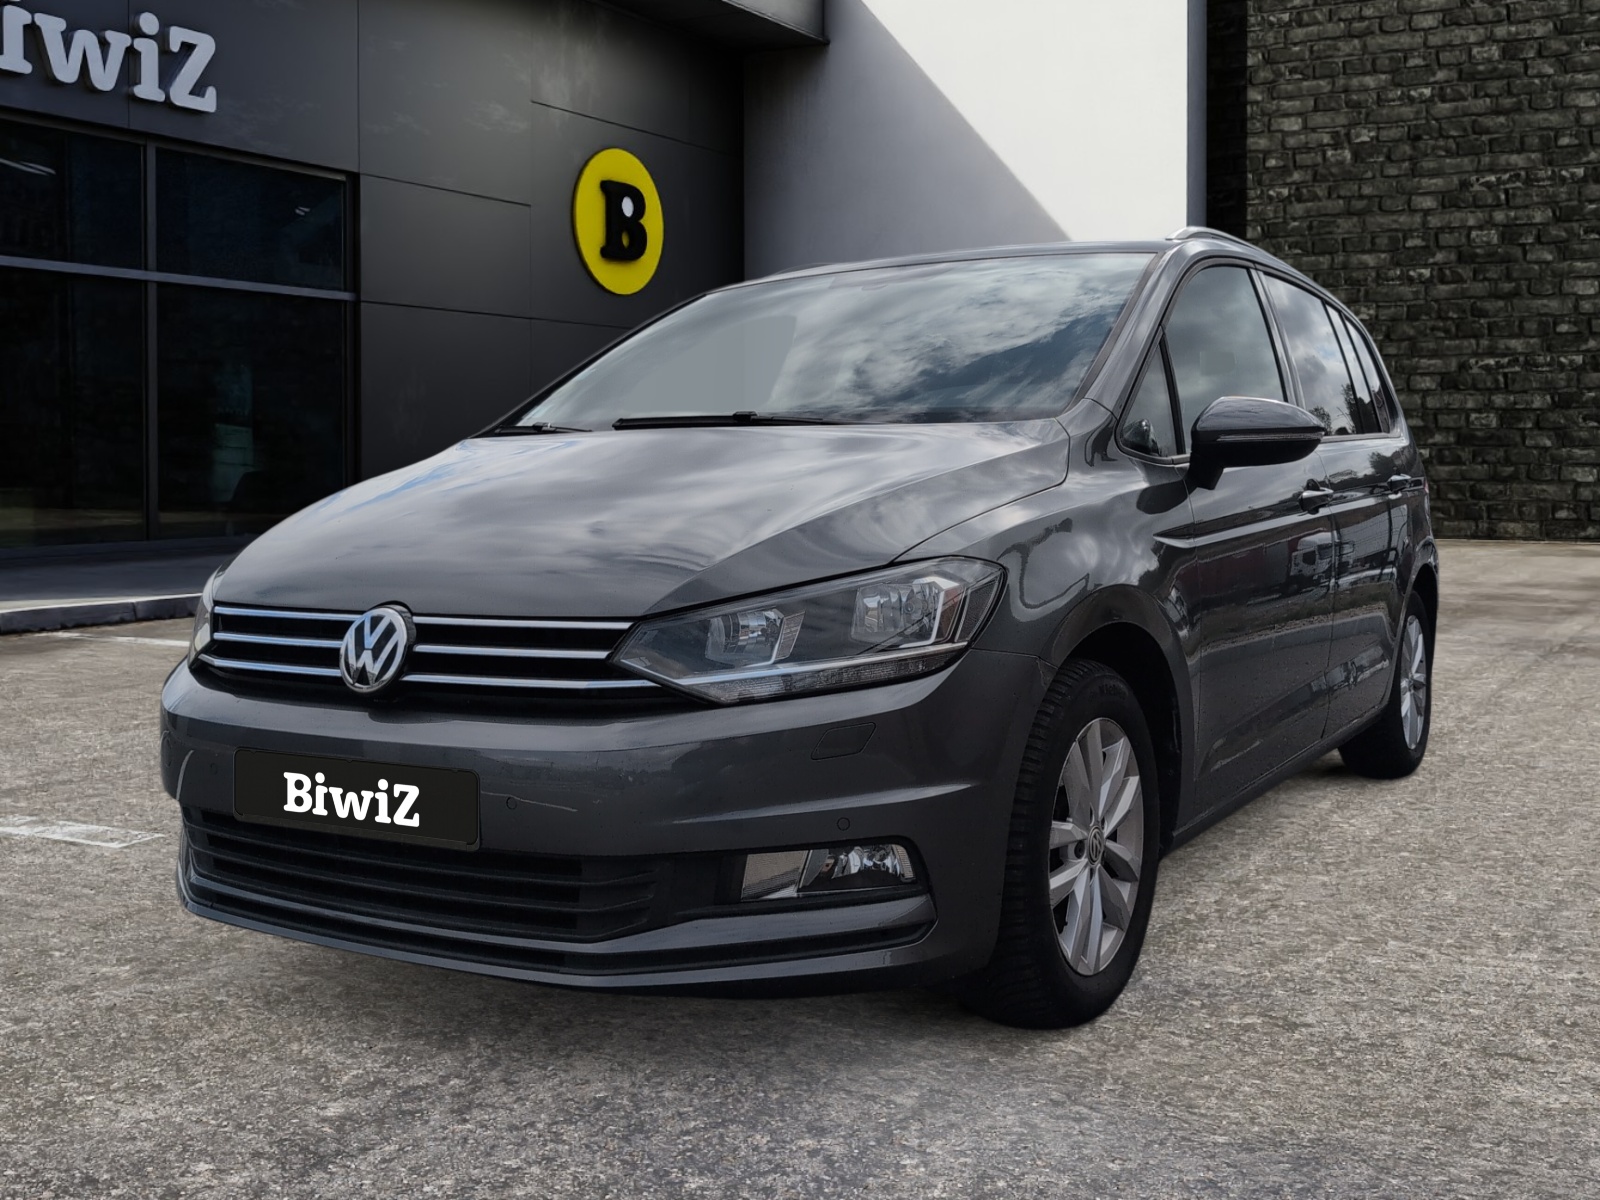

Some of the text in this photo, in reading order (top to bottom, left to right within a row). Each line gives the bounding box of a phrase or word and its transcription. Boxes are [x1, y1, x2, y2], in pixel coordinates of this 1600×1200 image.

[0, 0, 217, 113] iwiZ
[600, 179, 648, 262] B
[283, 772, 420, 828] BiwiZ
